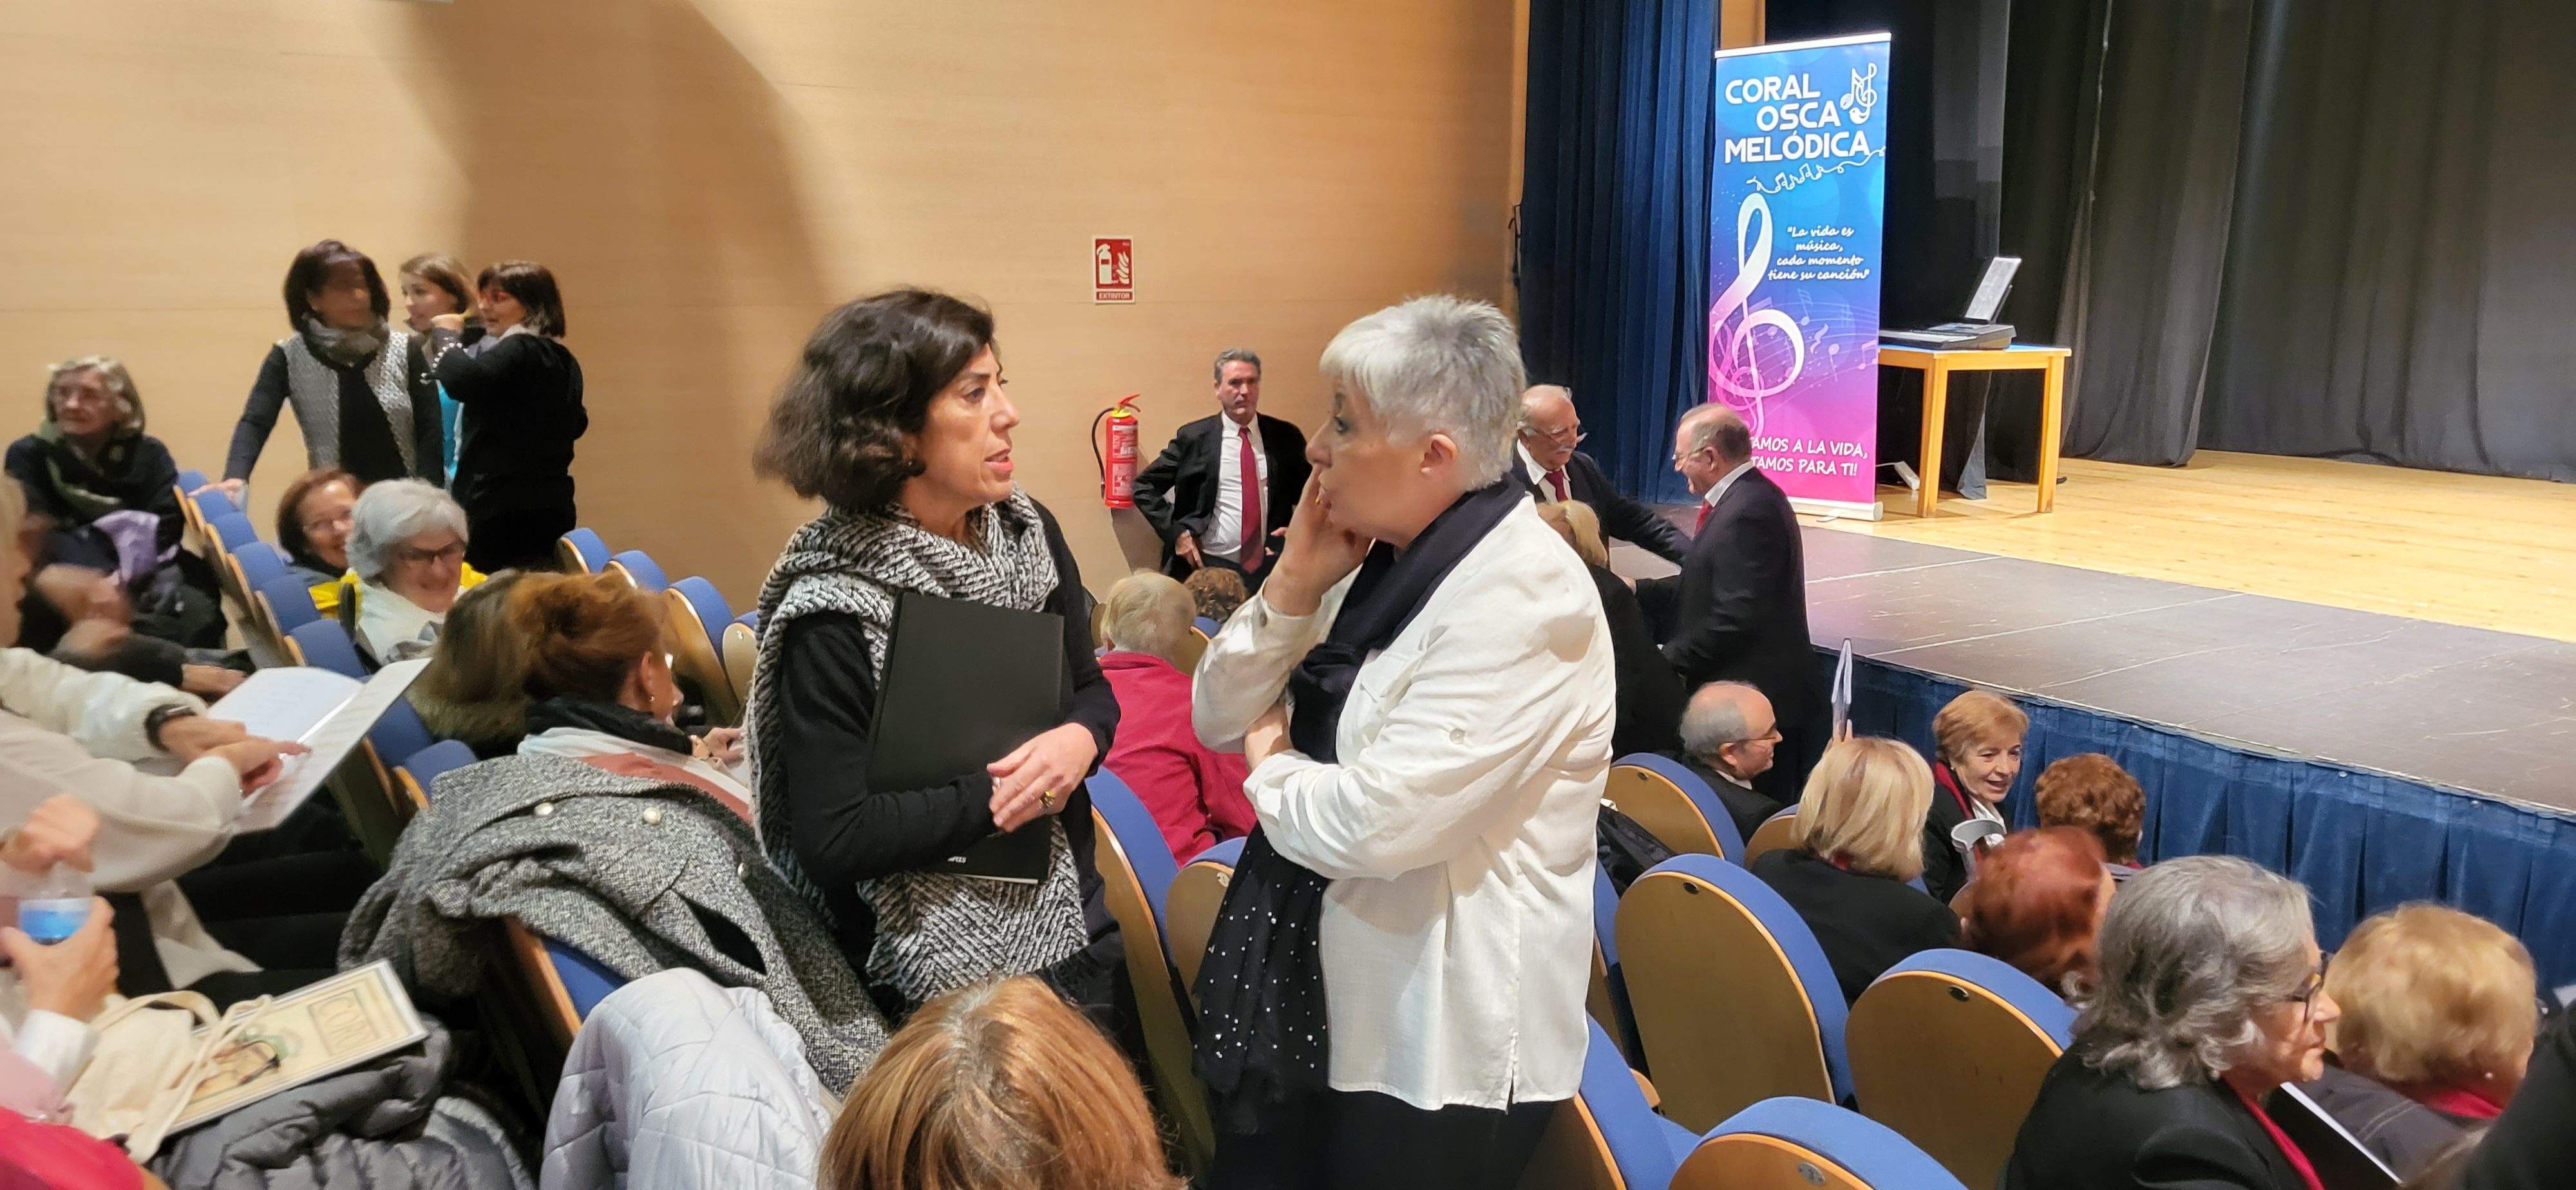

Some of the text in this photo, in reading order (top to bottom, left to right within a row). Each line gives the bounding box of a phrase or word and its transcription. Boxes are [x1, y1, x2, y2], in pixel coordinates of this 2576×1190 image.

[1725, 73, 1821, 104] CORAL
[1756, 100, 1841, 131] OSCA
[1725, 130, 1869, 164] MELÓDICA
[1810, 225, 1839, 237] vida
[1841, 227, 1855, 237] es
[1795, 239, 1844, 252] música,
[1776, 254, 1864, 266] cada momento
[1768, 268, 1799, 281] tiene
[1799, 271, 1816, 281] su
[1792, 438, 1803, 453] A
[1807, 439, 1826, 455] LA
[1830, 440, 1868, 459] VIDA,
[1798, 457, 1837, 475] PARA
[1840, 462, 1859, 477] TI!
